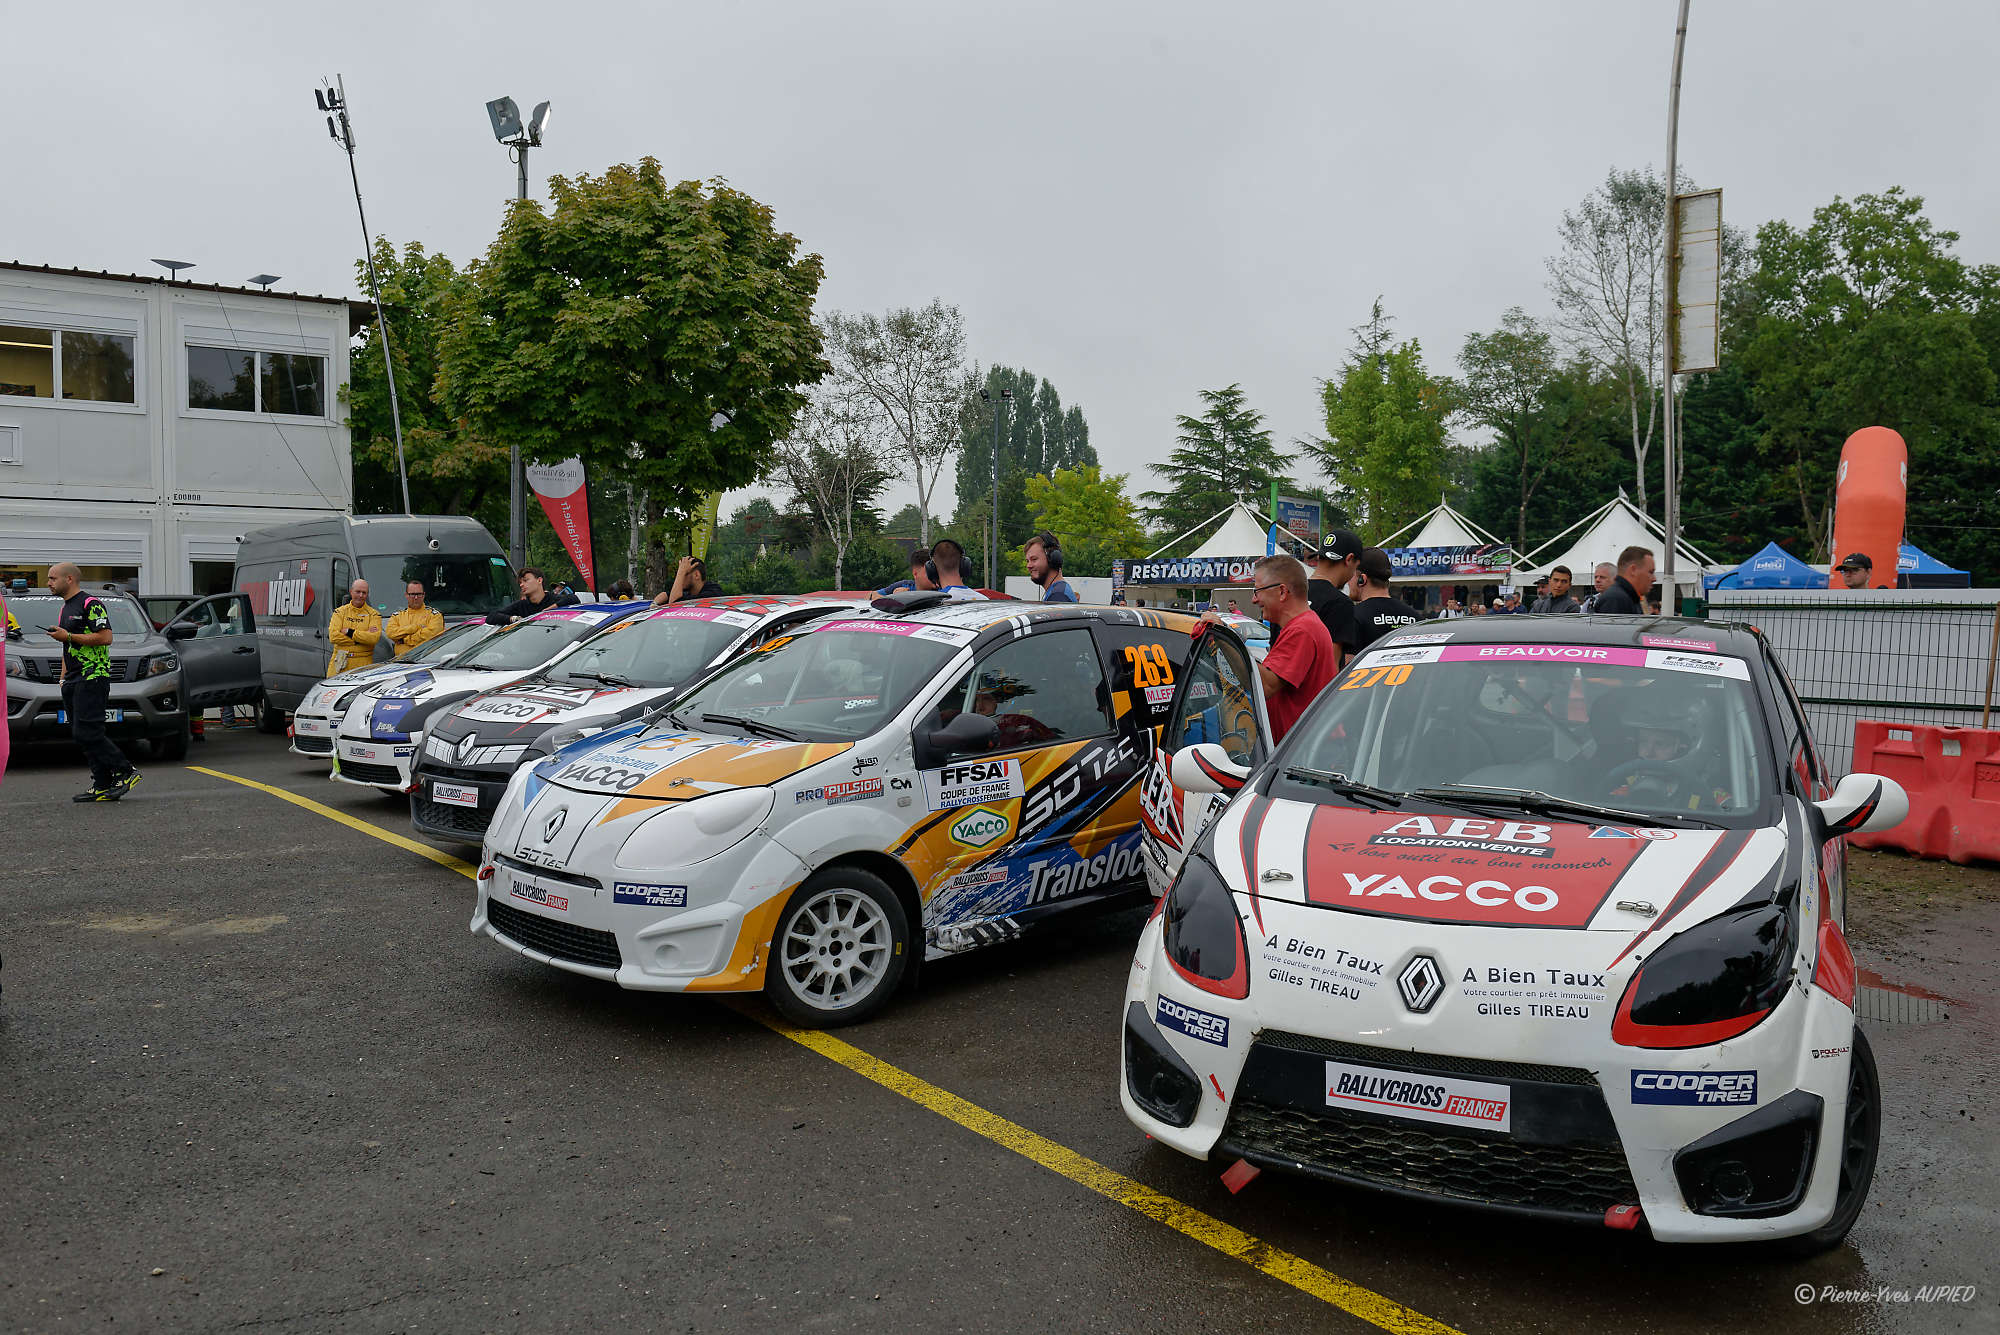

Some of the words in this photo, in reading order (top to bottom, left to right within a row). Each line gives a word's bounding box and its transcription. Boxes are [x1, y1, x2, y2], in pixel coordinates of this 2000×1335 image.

[1131, 561, 1257, 579] RESTAURATION
[1416, 554, 1478, 566] OFFICIELLE
[1373, 613, 1416, 625] eleven
[1478, 646, 1609, 659] BEAUVOIR
[1124, 643, 1175, 689] 269
[1338, 664, 1414, 691] 270
[473, 702, 536, 718] YACCO
[557, 763, 647, 792] YACCO
[940, 762, 1004, 787] FFSA
[940, 788, 967, 800] COUPE
[969, 786, 980, 796] DE
[981, 782, 1010, 794] FRANCE
[940, 795, 984, 809] RALLYCROSS
[957, 819, 1005, 840] YACCO
[1382, 815, 1553, 844] AEB
[1327, 842, 1356, 853] Le
[1357, 846, 1391, 859] bon
[1396, 852, 1448, 864] outil
[1450, 856, 1480, 866] au
[1487, 856, 1522, 869] bon
[1531, 856, 1613, 870] moment
[1026, 843, 1149, 905] Transloc
[512, 880, 548, 904] RALLYCROSS
[547, 895, 568, 911] FRANCE
[615, 884, 686, 898] COOPER
[645, 896, 684, 906] TIRES
[1342, 872, 1559, 912] YACCO
[1265, 934, 1279, 949] A
[1286, 937, 1326, 960] Bien
[1336, 949, 1385, 976] Taux
[1263, 952, 1282, 964] Votre
[1283, 957, 1310, 970] courtier
[1311, 965, 1321, 973] en
[1322, 967, 1338, 977] prêt
[1339, 971, 1378, 988] immobilier
[1462, 967, 1478, 983] A
[1488, 967, 1536, 984] Bien
[1546, 969, 1606, 988] Taux
[1268, 968, 1304, 986] Gilles
[1310, 977, 1361, 1001] TIREAU
[1463, 988, 1488, 997] Votre
[1489, 988, 1523, 998] courtier
[1539, 990, 1558, 1000] prêt
[1560, 991, 1606, 1001] immobilier
[1157, 997, 1228, 1034] COOPER
[1477, 1003, 1521, 1016] Gilles
[1528, 1004, 1590, 1019] TIREAU
[1183, 1021, 1225, 1042] TIRES
[1634, 1073, 1756, 1091] COOPER
[1336, 1072, 1446, 1108] RALLYCROSS
[1447, 1096, 1504, 1120] FRANCE
[1695, 1090, 1754, 1103] TIRES
